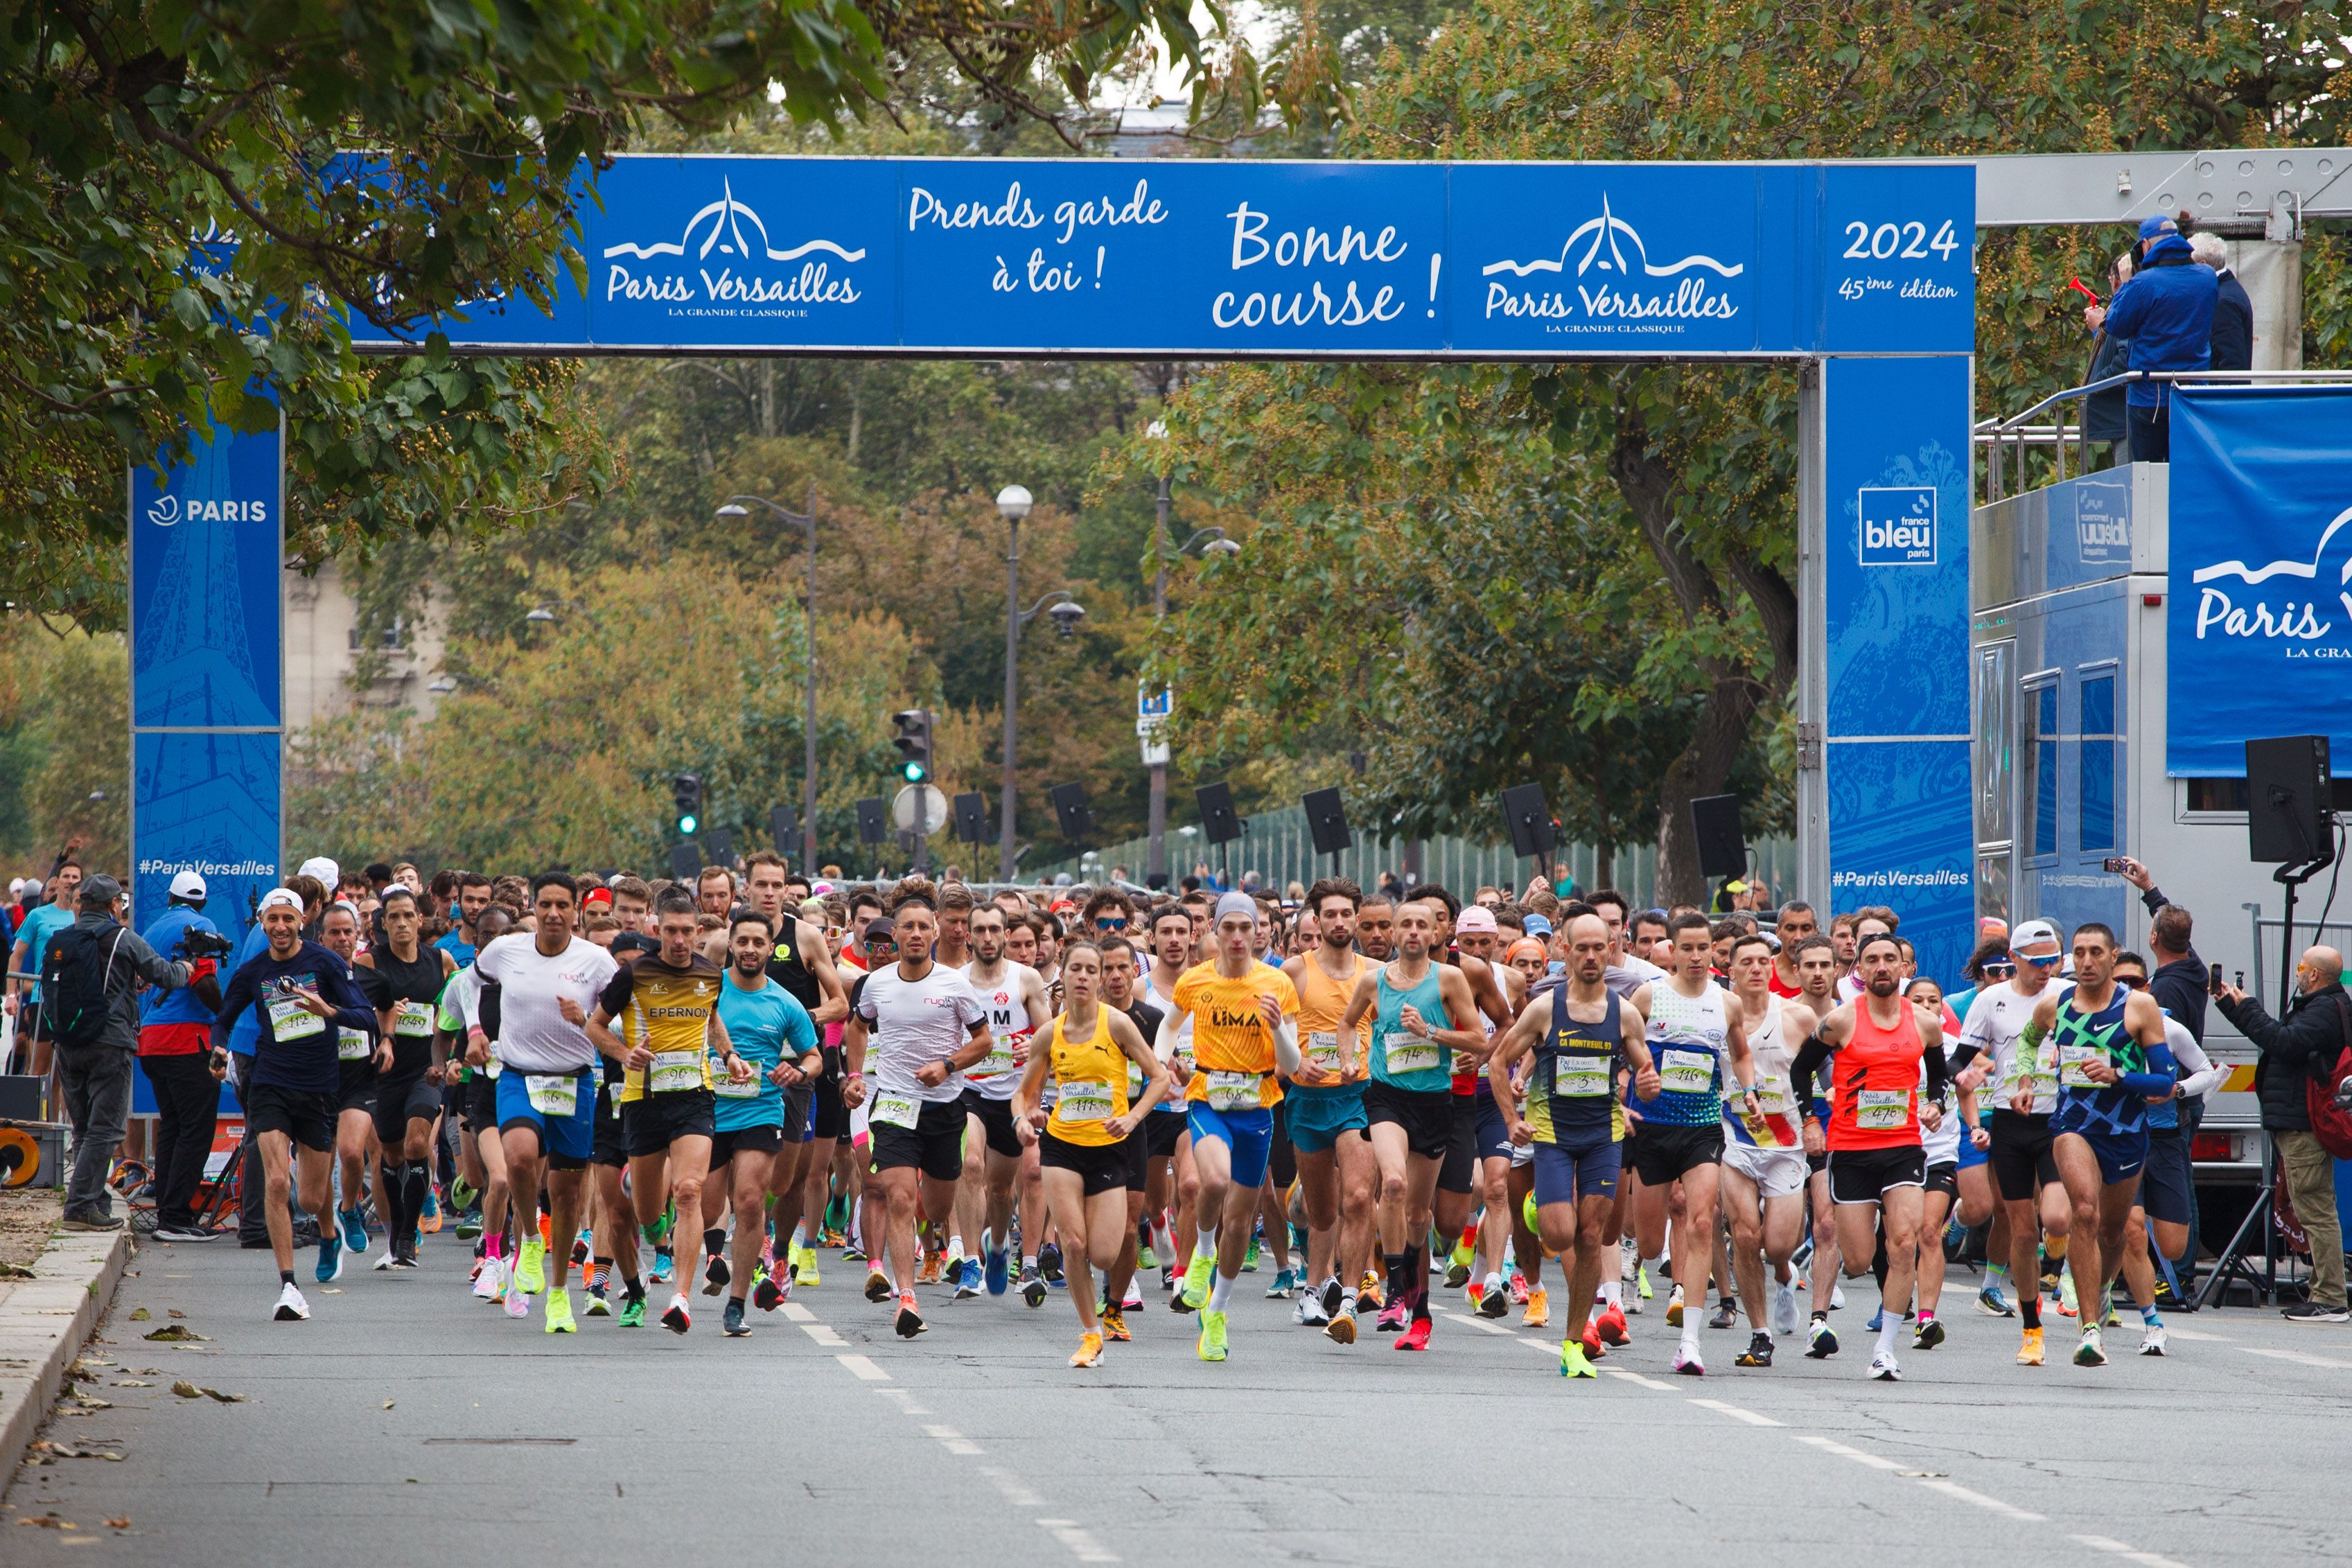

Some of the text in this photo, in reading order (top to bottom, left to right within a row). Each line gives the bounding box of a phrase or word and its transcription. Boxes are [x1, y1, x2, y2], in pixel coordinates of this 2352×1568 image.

[909, 179, 1168, 244] Prends garde
[1227, 201, 1407, 270] Bonne
[1843, 219, 1959, 261] 2024
[992, 246, 1105, 292] à toi !
[608, 262, 861, 303] Paris Versailles
[1900, 278, 1958, 299] édition
[1212, 253, 1442, 328] course !
[1486, 277, 1739, 319] Paris Versailles
[740, 309, 807, 318] CLASSIQUE
[1617, 325, 1685, 334] CLASSIQUE
[188, 500, 266, 522] PARIS
[1901, 516, 1930, 527] france
[1866, 521, 1930, 548] bleu
[1907, 548, 1930, 559] paris
[2196, 588, 2331, 640] Paris
[2286, 648, 2309, 658] LA
[139, 858, 274, 877] #ParisVersailles
[1832, 870, 1969, 888] #ParisVersailles
[649, 1007, 709, 1018] EPERNON
[1212, 1011, 1262, 1028] LIMA
[290, 1014, 309, 1028] 112
[1559, 1038, 1612, 1050] CA MONTREUIL 93
[1402, 1047, 1422, 1065] 74
[669, 1068, 687, 1082] 90
[1578, 1075, 1588, 1089] 3
[1677, 1068, 1699, 1082] 116
[543, 1090, 560, 1104] 66
[1064, 1086, 1096, 1097] Versailles
[1225, 1088, 1243, 1101] 68
[1075, 1099, 1096, 1111] 111
[1864, 1095, 1897, 1105] Versailles
[1872, 1104, 1897, 1122] 476
